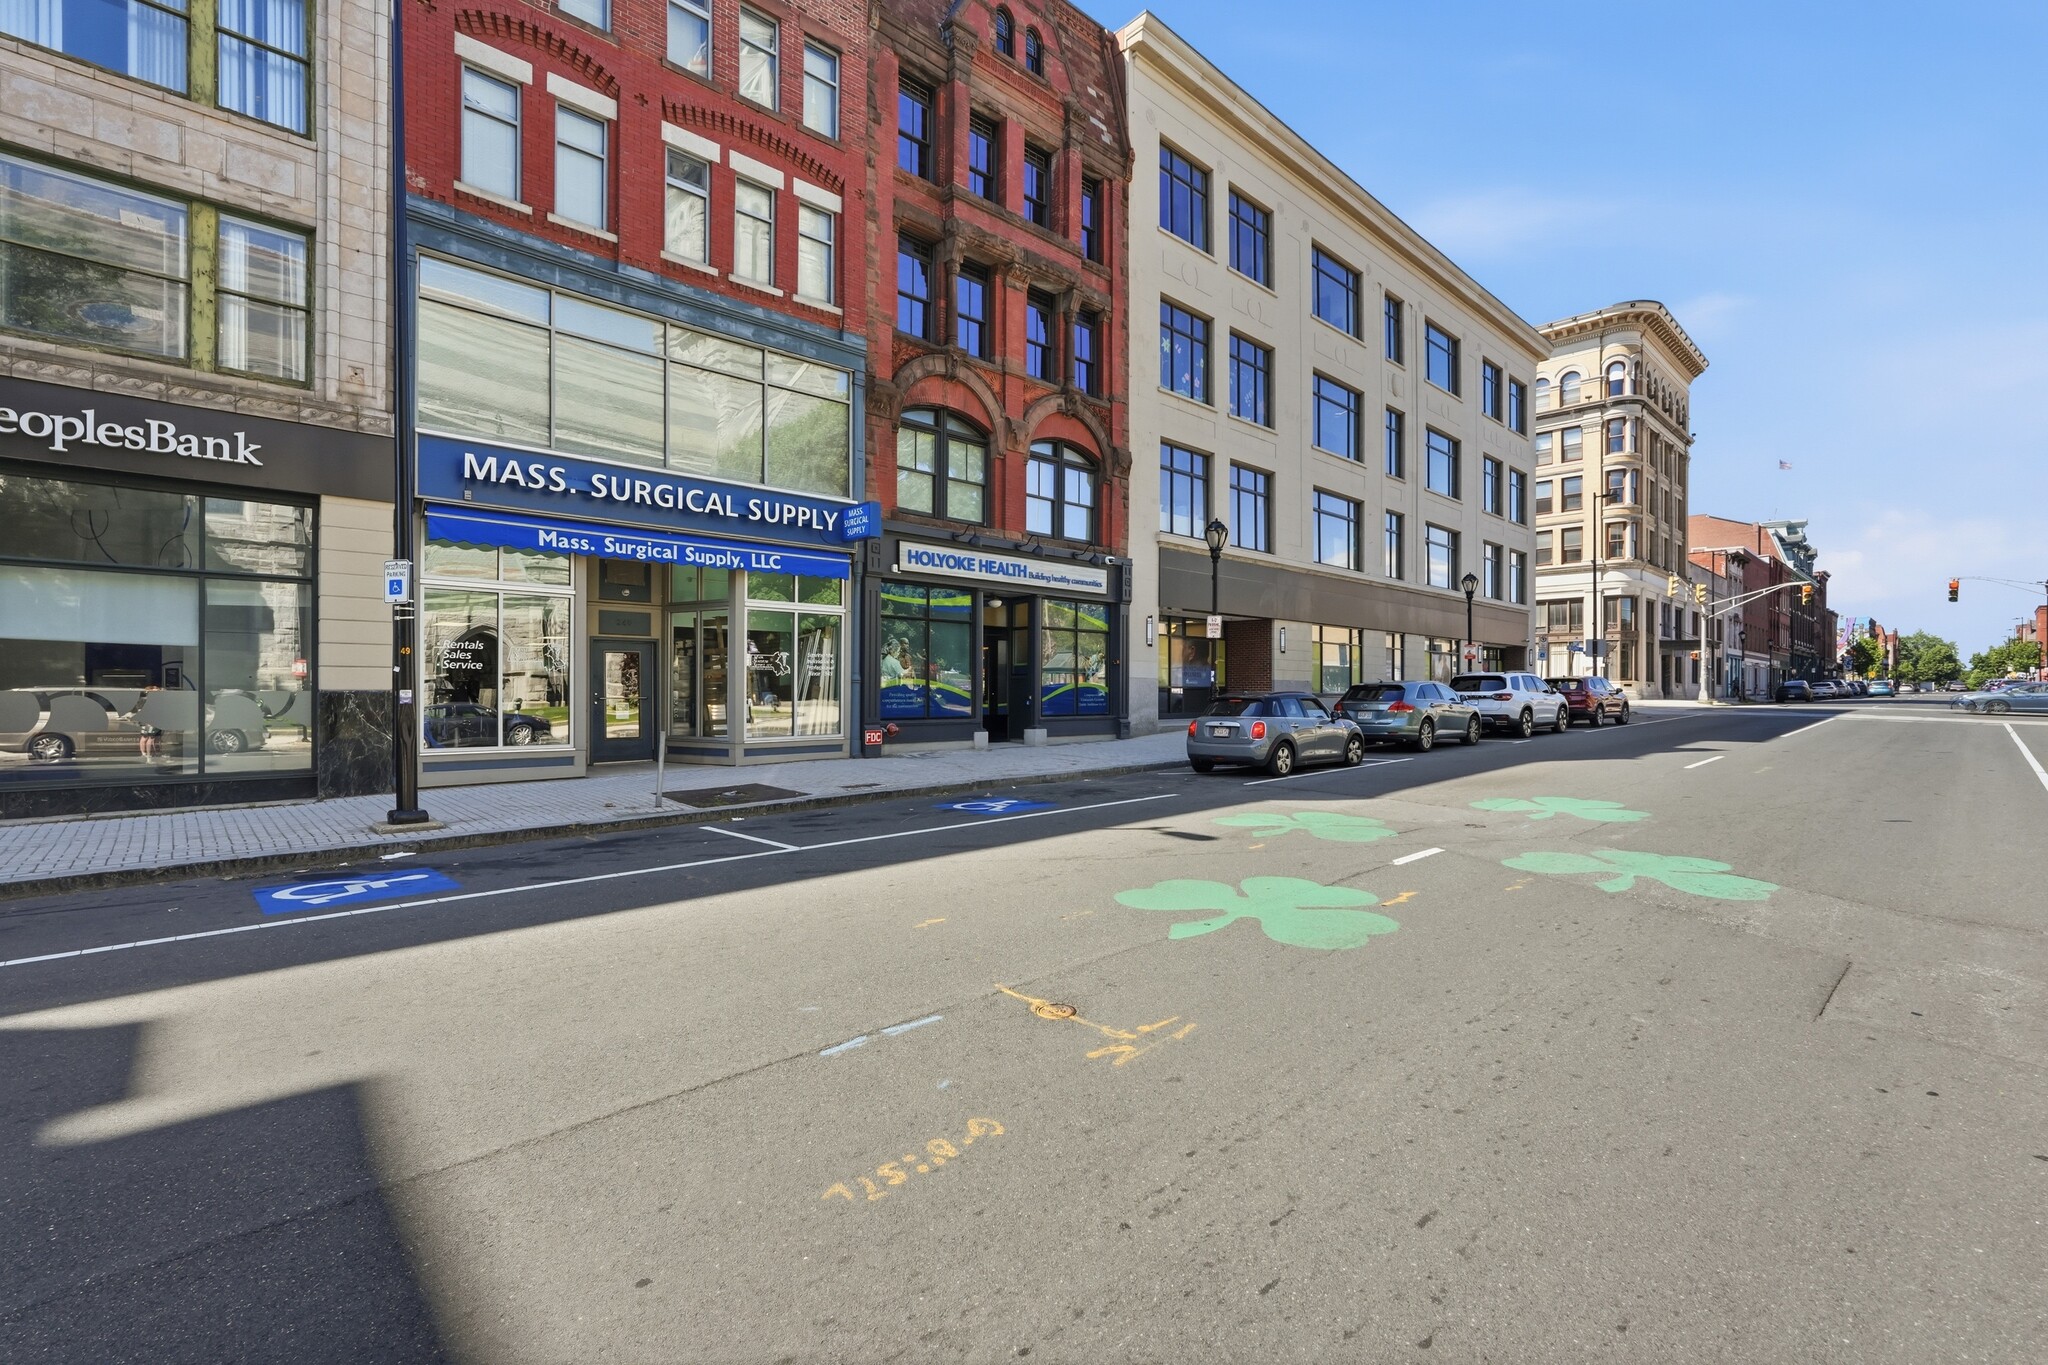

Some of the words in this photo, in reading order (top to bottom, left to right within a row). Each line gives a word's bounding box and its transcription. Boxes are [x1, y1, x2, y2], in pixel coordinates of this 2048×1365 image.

[464, 452, 577, 494] MASS.
[590, 473, 739, 518] SURGICAL
[748, 498, 839, 531] SUPPLY
[844, 515, 869, 528] SURGICAL
[847, 525, 866, 537] SUPPLY
[538, 529, 596, 551] Mass.
[604, 537, 678, 560] Surgical
[685, 546, 744, 569] Supply,
[751, 553, 782, 570] LLC
[907, 548, 976, 573] HOLYOKE
[979, 558, 1028, 579] HEALTH
[1028, 572, 1051, 583] Building
[1051, 575, 1071, 585] healthy
[1071, 578, 1103, 588] communities
[400, 646, 411, 655] 49
[442, 640, 484, 650] Rentals
[443, 650, 472, 660] Sales
[442, 660, 483, 670] Service
[866, 732, 882, 742] FDC
